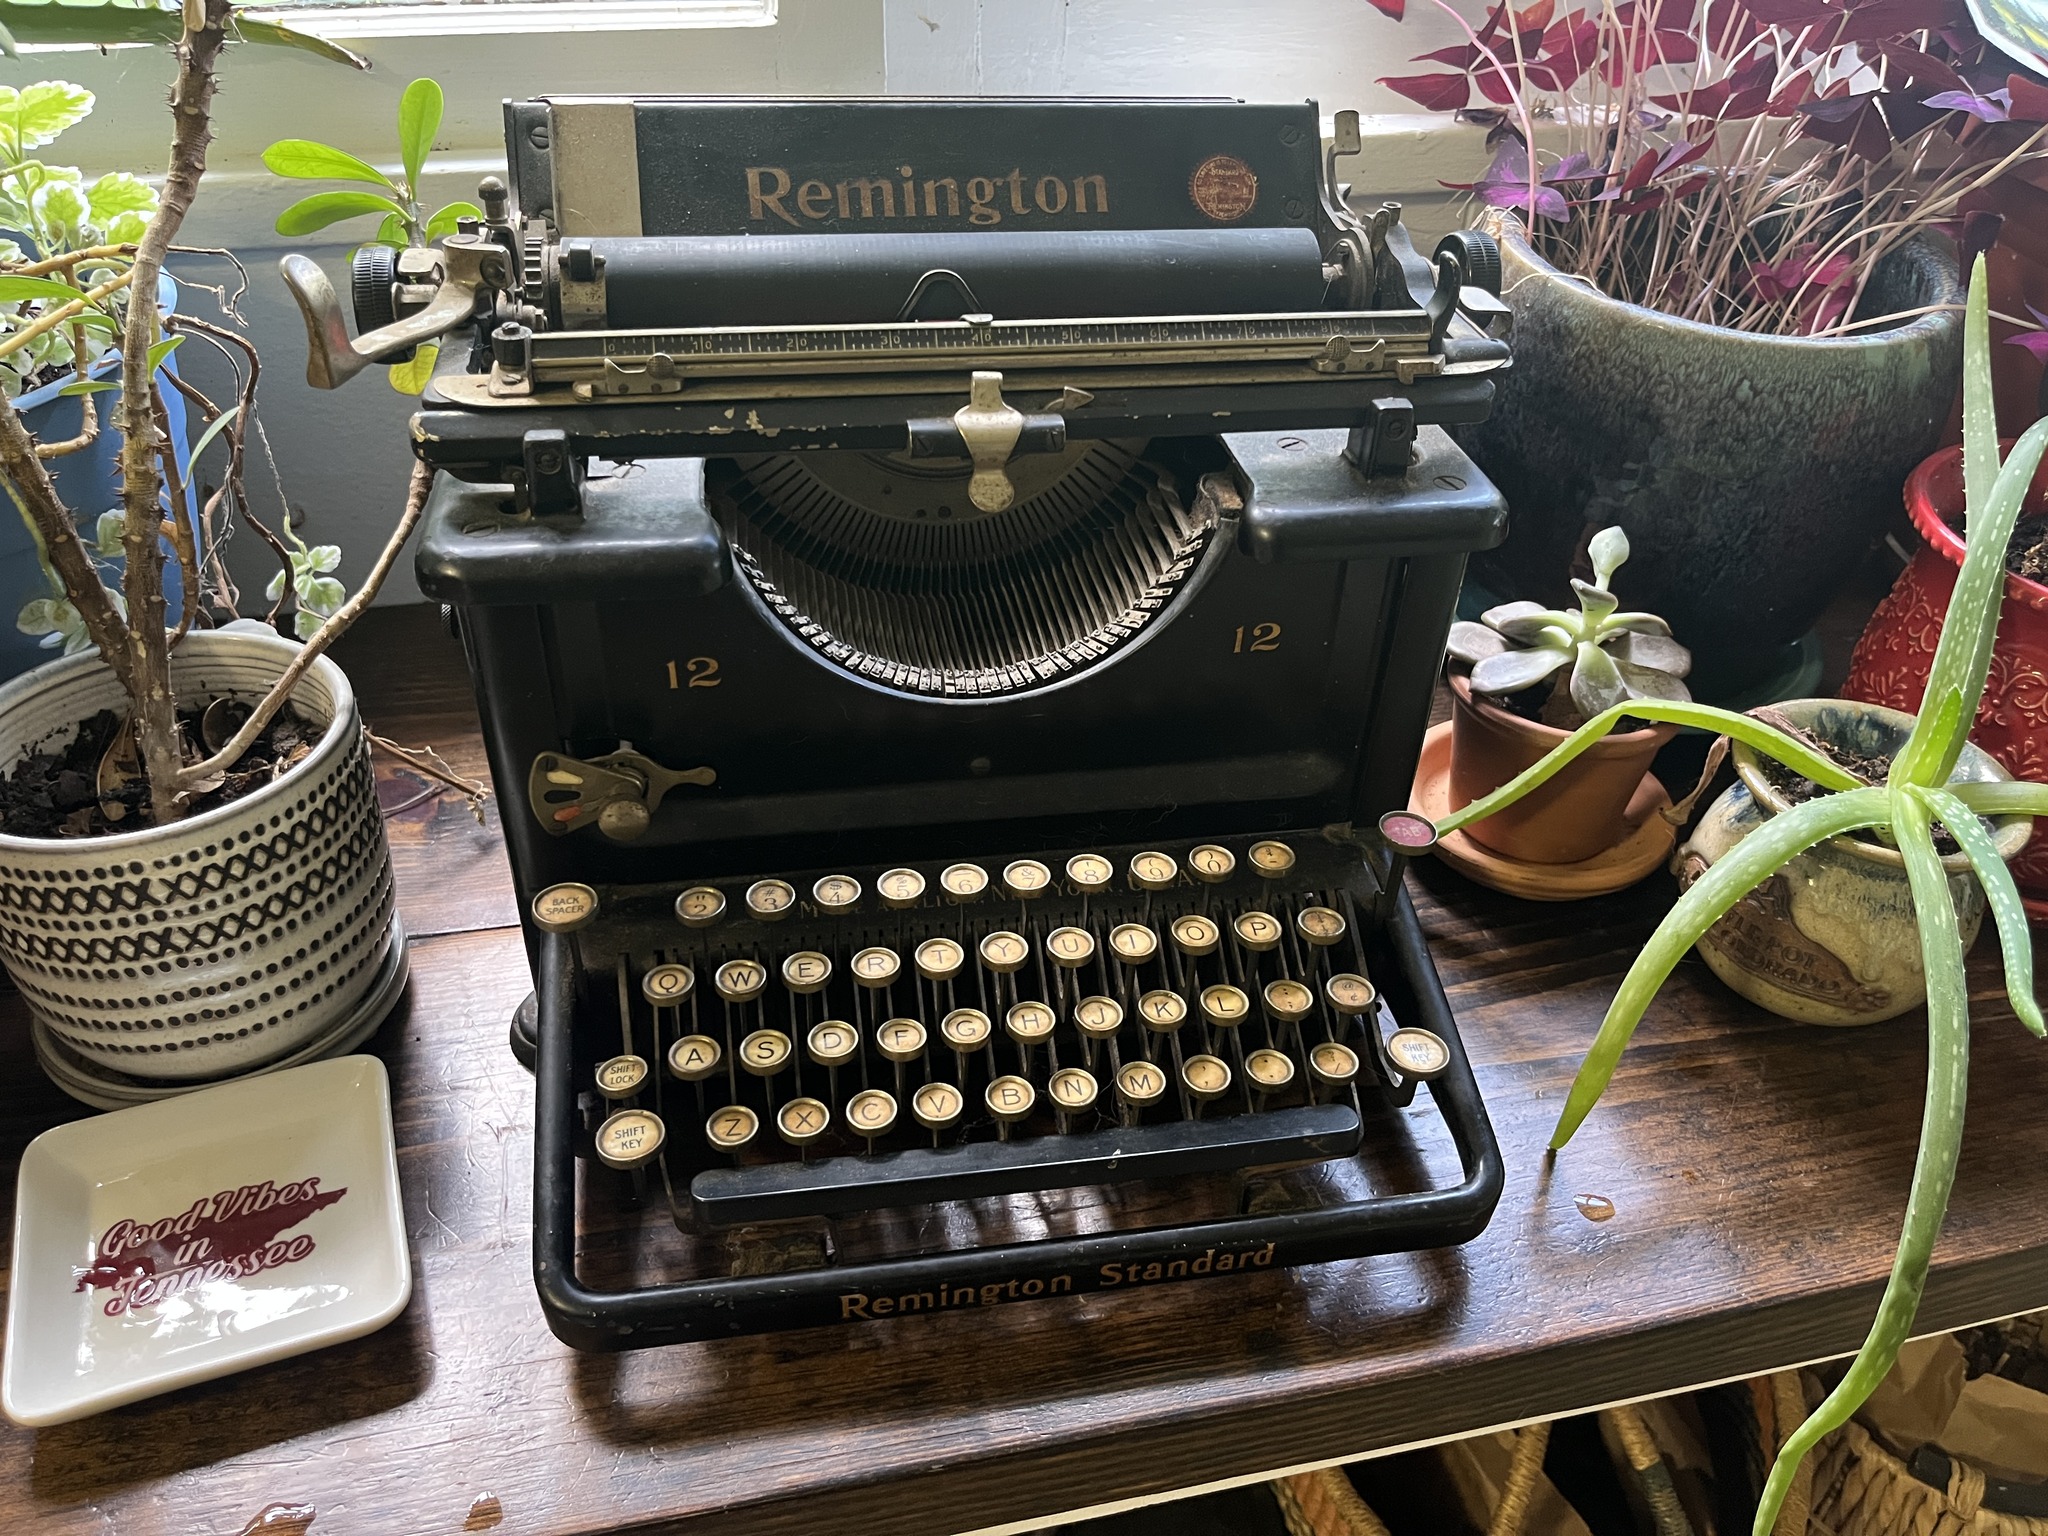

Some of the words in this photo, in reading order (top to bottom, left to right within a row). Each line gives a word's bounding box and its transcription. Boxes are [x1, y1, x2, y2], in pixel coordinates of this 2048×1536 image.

[745, 165, 1110, 227] Remington
[786, 337, 807, 349] 20
[880, 335, 901, 346] 30
[972, 332, 992, 343] 40
[1062, 329, 1081, 340] 50
[1233, 622, 1281, 653] 12
[666, 657, 722, 689] 12
[1084, 869, 1098, 882] 8
[1150, 867, 1163, 880] 9
[959, 879, 973, 893] 6
[1022, 877, 1035, 888] 7
[829, 892, 843, 904] 4
[897, 884, 909, 898] 5
[552, 896, 580, 906] BACK
[764, 898, 777, 911] 3
[545, 905, 585, 915] SPACER
[694, 904, 708, 915] 2
[1186, 926, 1204, 940] O
[1250, 922, 1267, 936] P
[1062, 938, 1079, 953] U
[1129, 934, 1136, 949] I
[931, 950, 948, 964] T
[994, 942, 1010, 957] Y
[798, 963, 814, 978] E
[867, 957, 885, 972] R
[659, 974, 678, 993] Q
[728, 971, 752, 987] W
[1154, 1001, 1173, 1018] K
[1217, 996, 1235, 1011] L
[1021, 1014, 1040, 1030] H
[1091, 1008, 1105, 1025] J
[955, 1020, 976, 1036] G
[823, 1032, 841, 1049] D
[895, 1030, 909, 1046] F
[757, 1042, 774, 1059] S
[1402, 1043, 1430, 1052] SHIFT
[685, 1048, 704, 1065] A
[1411, 1053, 1430, 1062] KEY
[610, 1064, 636, 1074] SHIFT
[610, 1074, 635, 1085] LOCK
[1129, 1074, 1152, 1091] M
[1063, 1079, 1083, 1097] N
[929, 1095, 946, 1113] V
[1001, 1088, 1021, 1105] B
[862, 1103, 881, 1120] C
[725, 1118, 742, 1136] Z
[795, 1110, 814, 1129] X
[614, 1125, 646, 1139] SHIFT
[621, 1138, 643, 1150] KEY
[99, 1199, 209, 1259] Good
[212, 1177, 320, 1223] Vibes
[172, 1233, 214, 1266] in
[104, 1235, 316, 1316] Tennessee
[839, 1273, 1072, 1321] Remington
[1099, 1242, 1276, 1287] Standard
